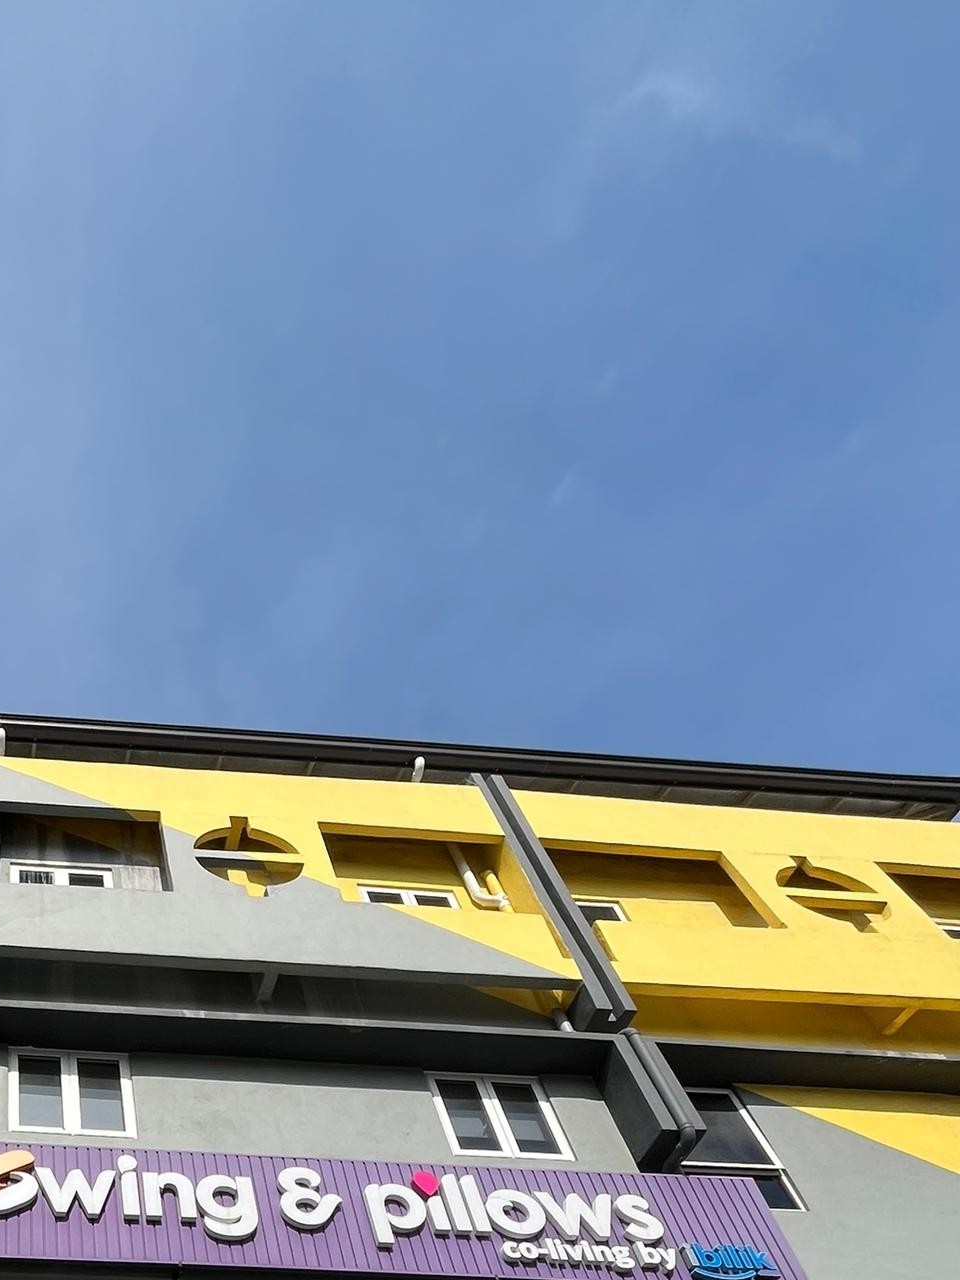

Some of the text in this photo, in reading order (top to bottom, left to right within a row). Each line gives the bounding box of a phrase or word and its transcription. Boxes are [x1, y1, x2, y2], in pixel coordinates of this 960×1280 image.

[277, 1166, 342, 1233] &
[363, 1171, 665, 1251] pillows
[501, 1239, 777, 1274] co-living by ibilik
